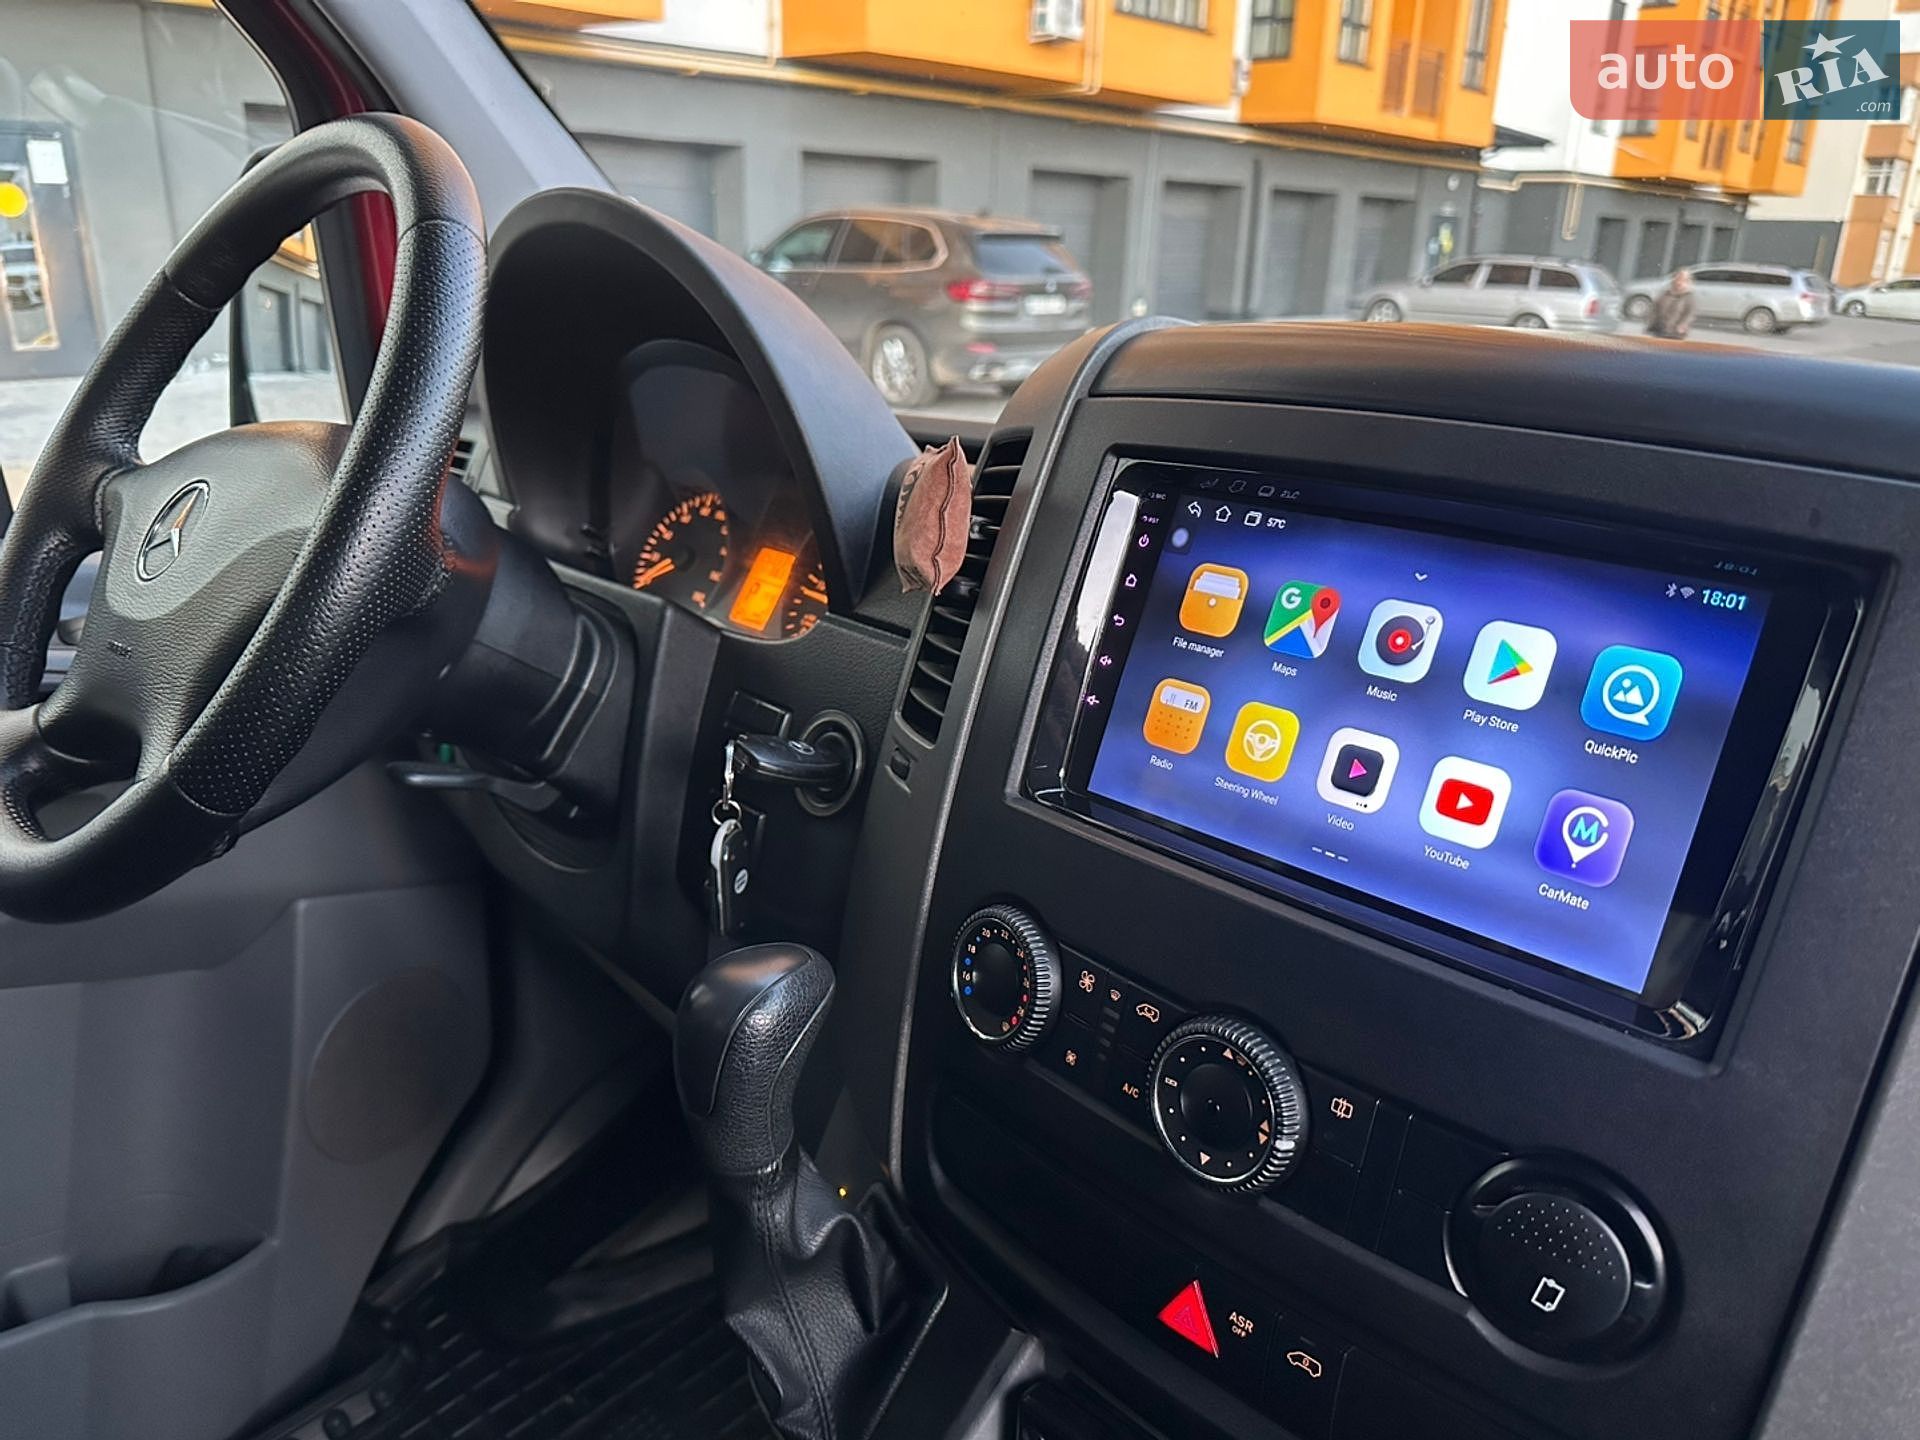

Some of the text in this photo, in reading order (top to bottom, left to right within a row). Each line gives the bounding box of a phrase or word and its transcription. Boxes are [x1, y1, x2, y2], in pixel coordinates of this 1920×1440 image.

[1281, 586, 1303, 610] G
[1702, 588, 1748, 611] 18:01
[1172, 636, 1225, 658] File manager
[1272, 661, 1298, 676] Maps
[1366, 684, 1398, 701] Music
[1184, 699, 1200, 711] FM
[1463, 708, 1520, 733] Play Store
[1150, 754, 1174, 770] Radio
[1584, 739, 1639, 764] QuickPic
[1214, 776, 1280, 806] Steering Wheel
[1327, 813, 1355, 831] Video
[1424, 844, 1471, 870] YouTube
[1538, 883, 1590, 910] CarMate
[967, 943, 977, 954] 18
[962, 970, 972, 981] 16
[1122, 1082, 1140, 1099] A/C
[1229, 1311, 1254, 1334] ASR
